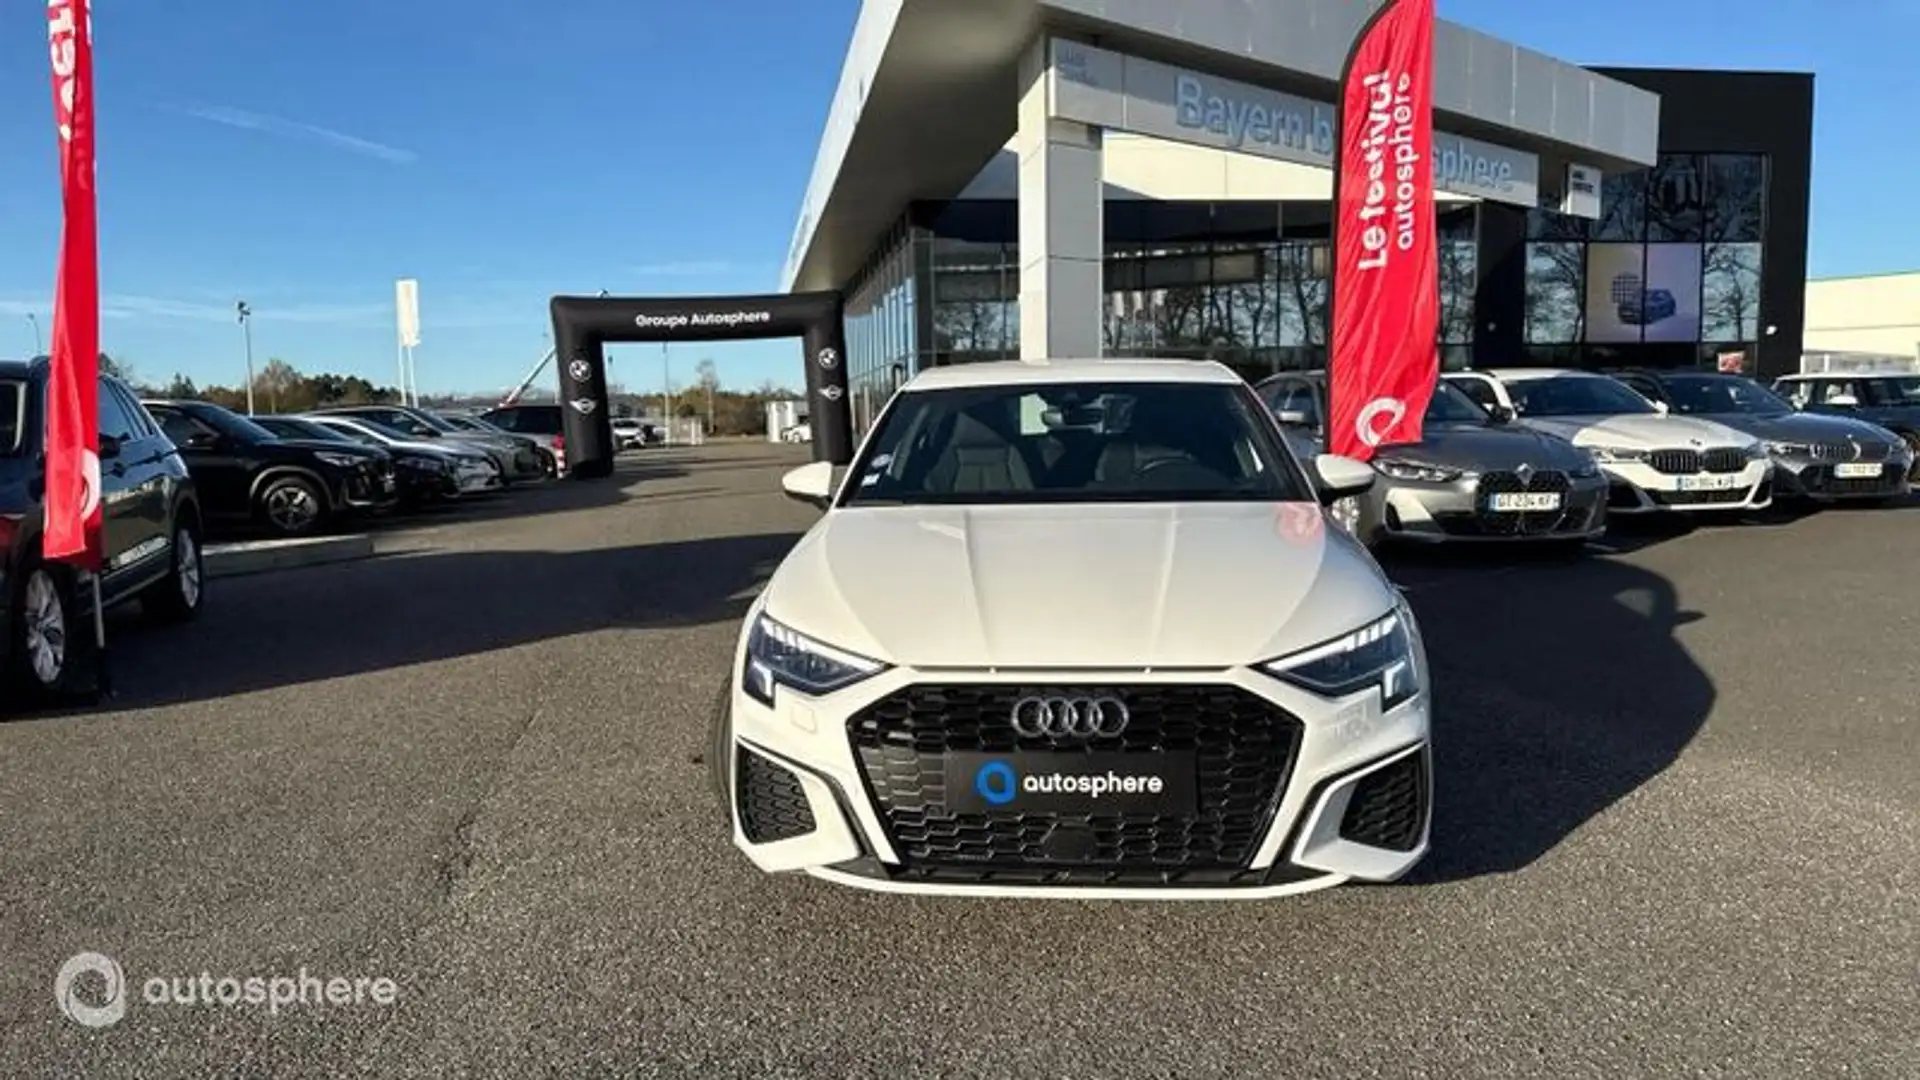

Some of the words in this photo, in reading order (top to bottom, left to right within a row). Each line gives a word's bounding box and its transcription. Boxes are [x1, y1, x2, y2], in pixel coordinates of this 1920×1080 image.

[1176, 75, 1305, 149] Bayern
[1312, 106, 1335, 155] b
[1388, 72, 1420, 250] autosphere
[1358, 225, 1388, 270] Le
[635, 314, 688, 330] Groupe
[690, 311, 770, 327] Autosphere
[1023, 770, 1163, 798] autosphere
